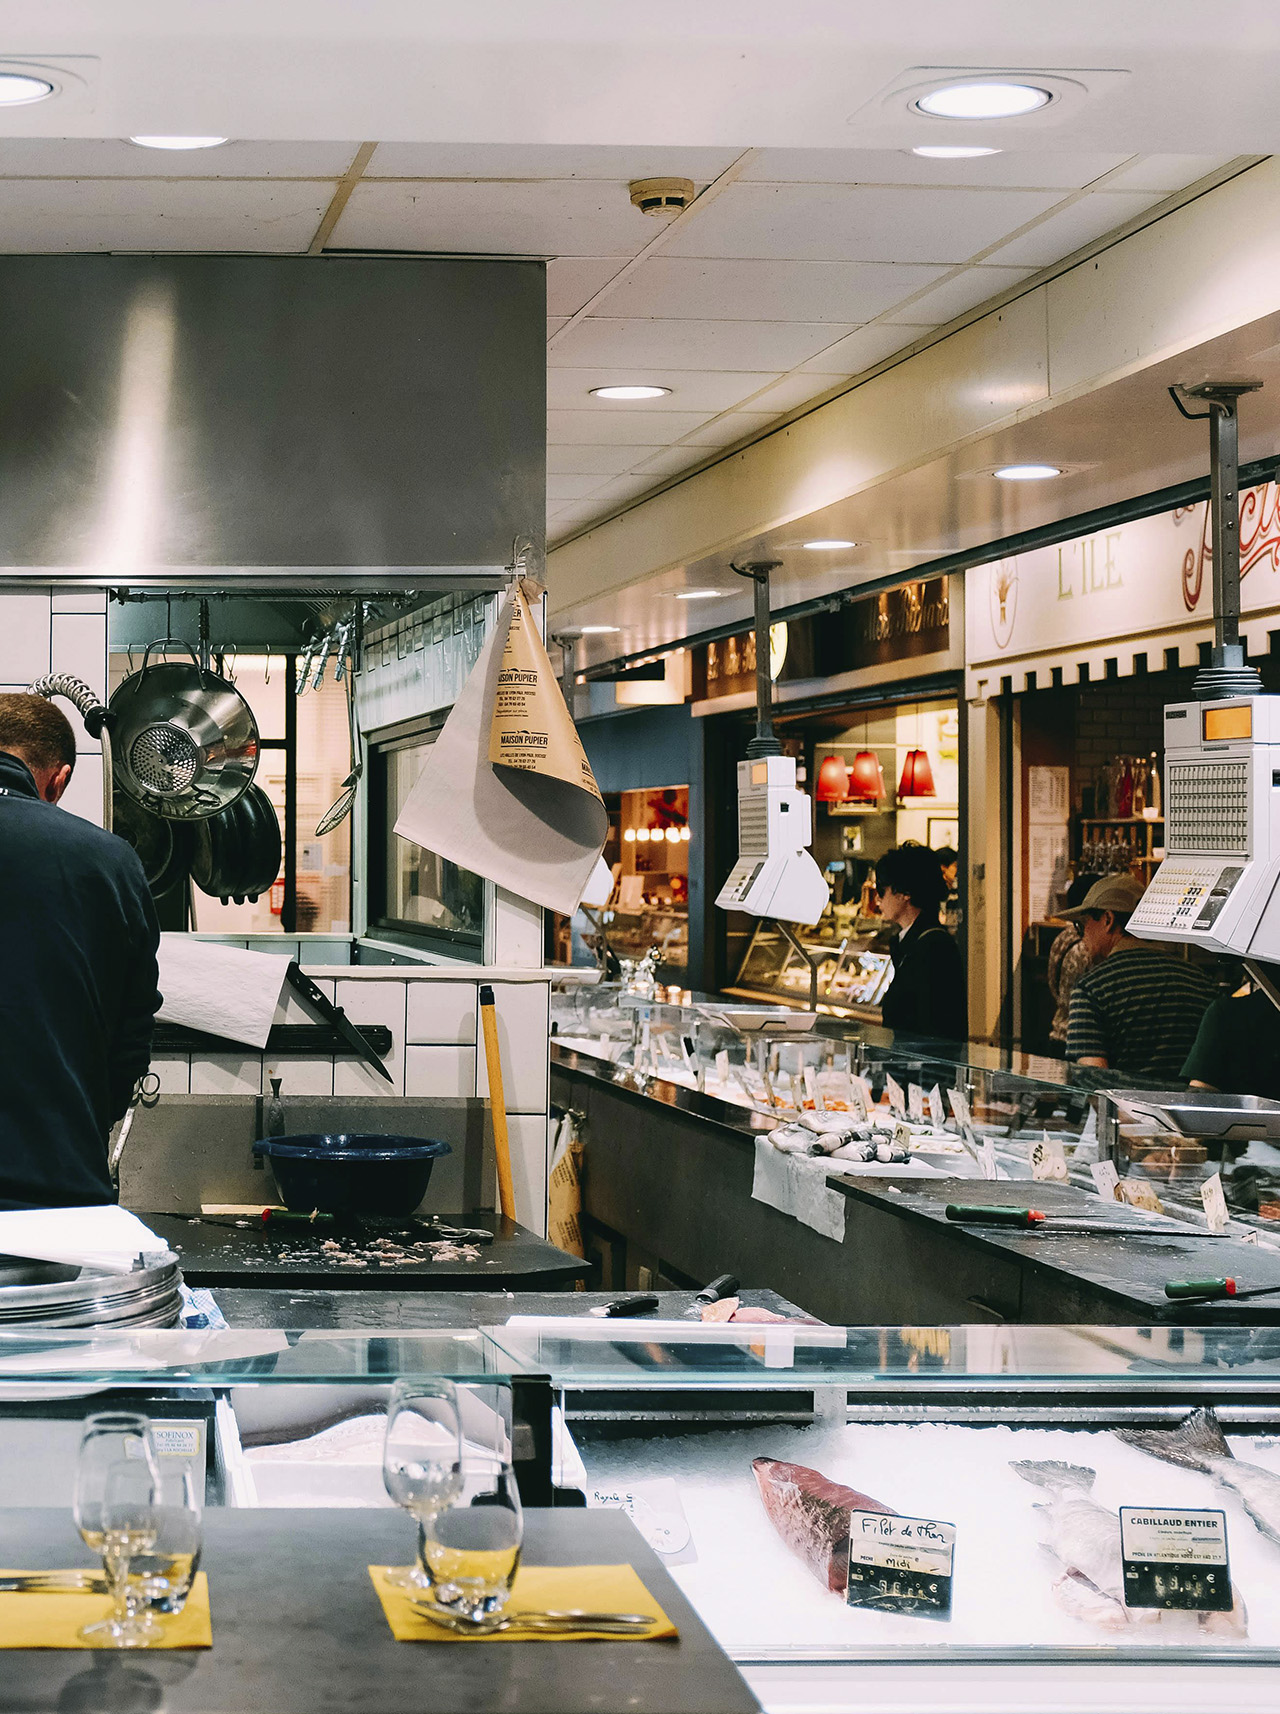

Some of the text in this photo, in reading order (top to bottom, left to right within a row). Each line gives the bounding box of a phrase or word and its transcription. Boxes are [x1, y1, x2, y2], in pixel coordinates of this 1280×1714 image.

[514, 673, 538, 683] PUPIER
[501, 735, 548, 745] MAISON PUPIER
[157, 1431, 193, 1439] SOFINOX
[862, 1518, 897, 1536] Filet
[901, 1525, 912, 1537] de
[1131, 1518, 1218, 1528] CABILLAUD ENTIER
[886, 1558, 911, 1569] Midi
